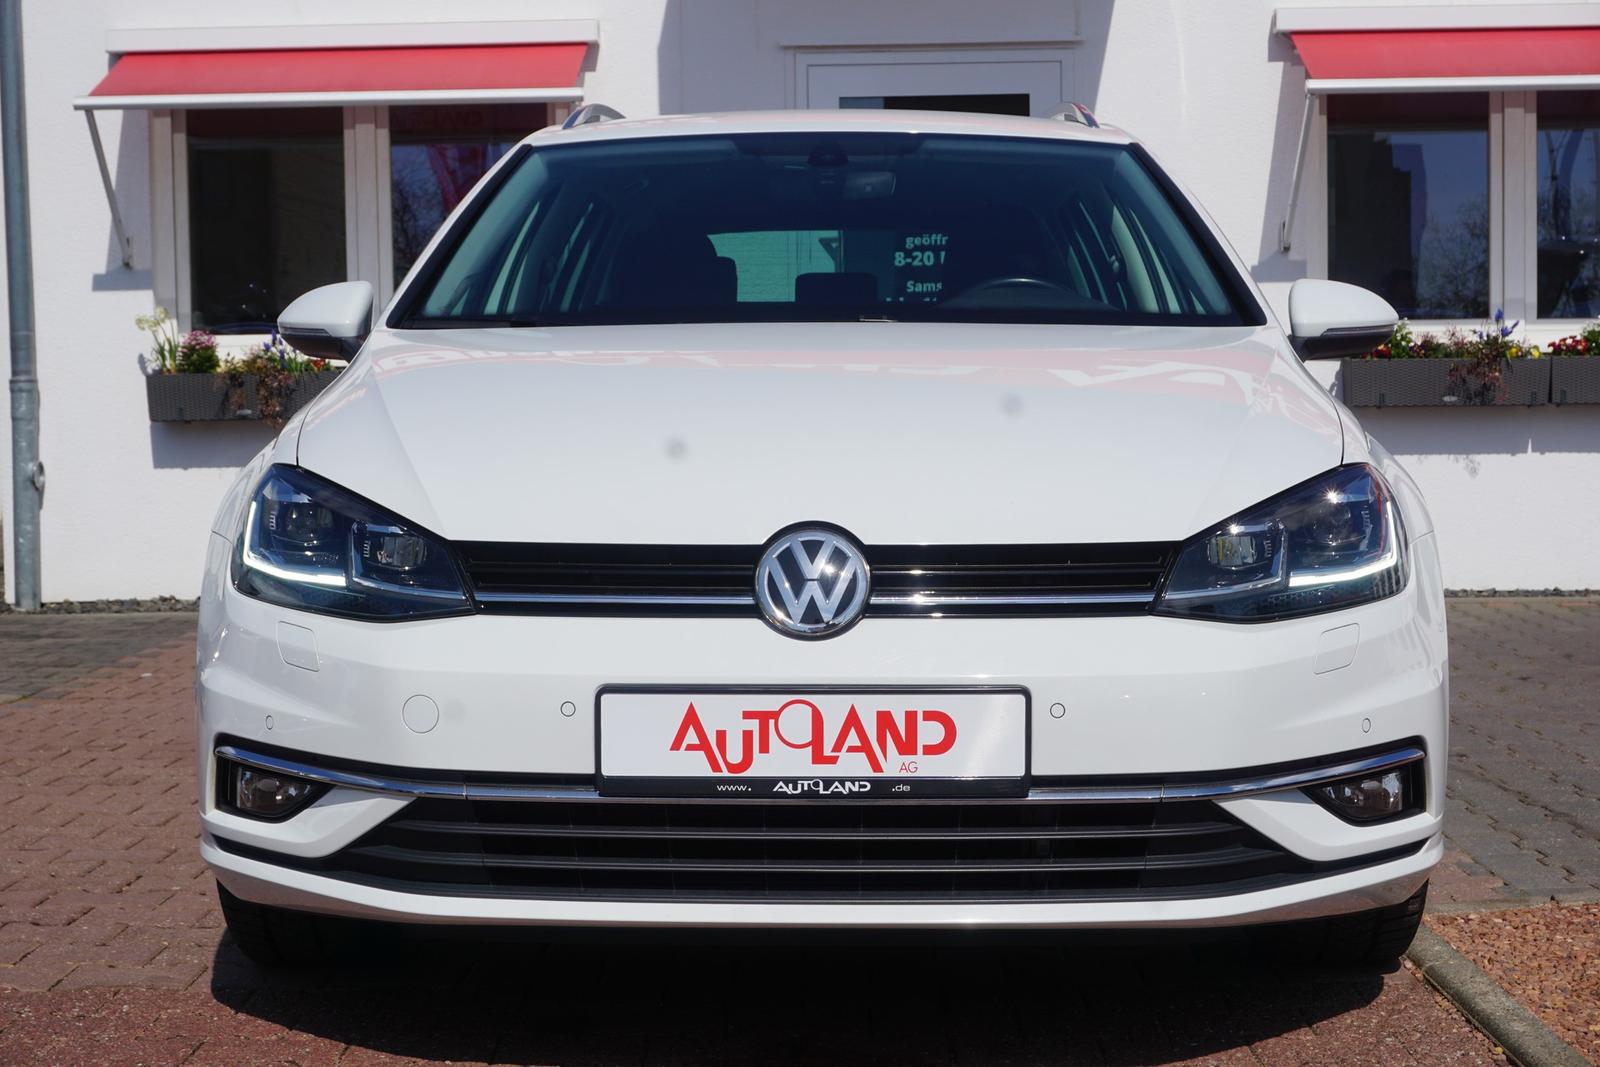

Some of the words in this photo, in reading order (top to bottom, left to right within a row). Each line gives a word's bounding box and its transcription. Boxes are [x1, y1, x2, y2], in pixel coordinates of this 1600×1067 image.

[894, 251, 935, 266] 8-20
[898, 760, 919, 773] AG
[891, 783, 911, 792] .de
